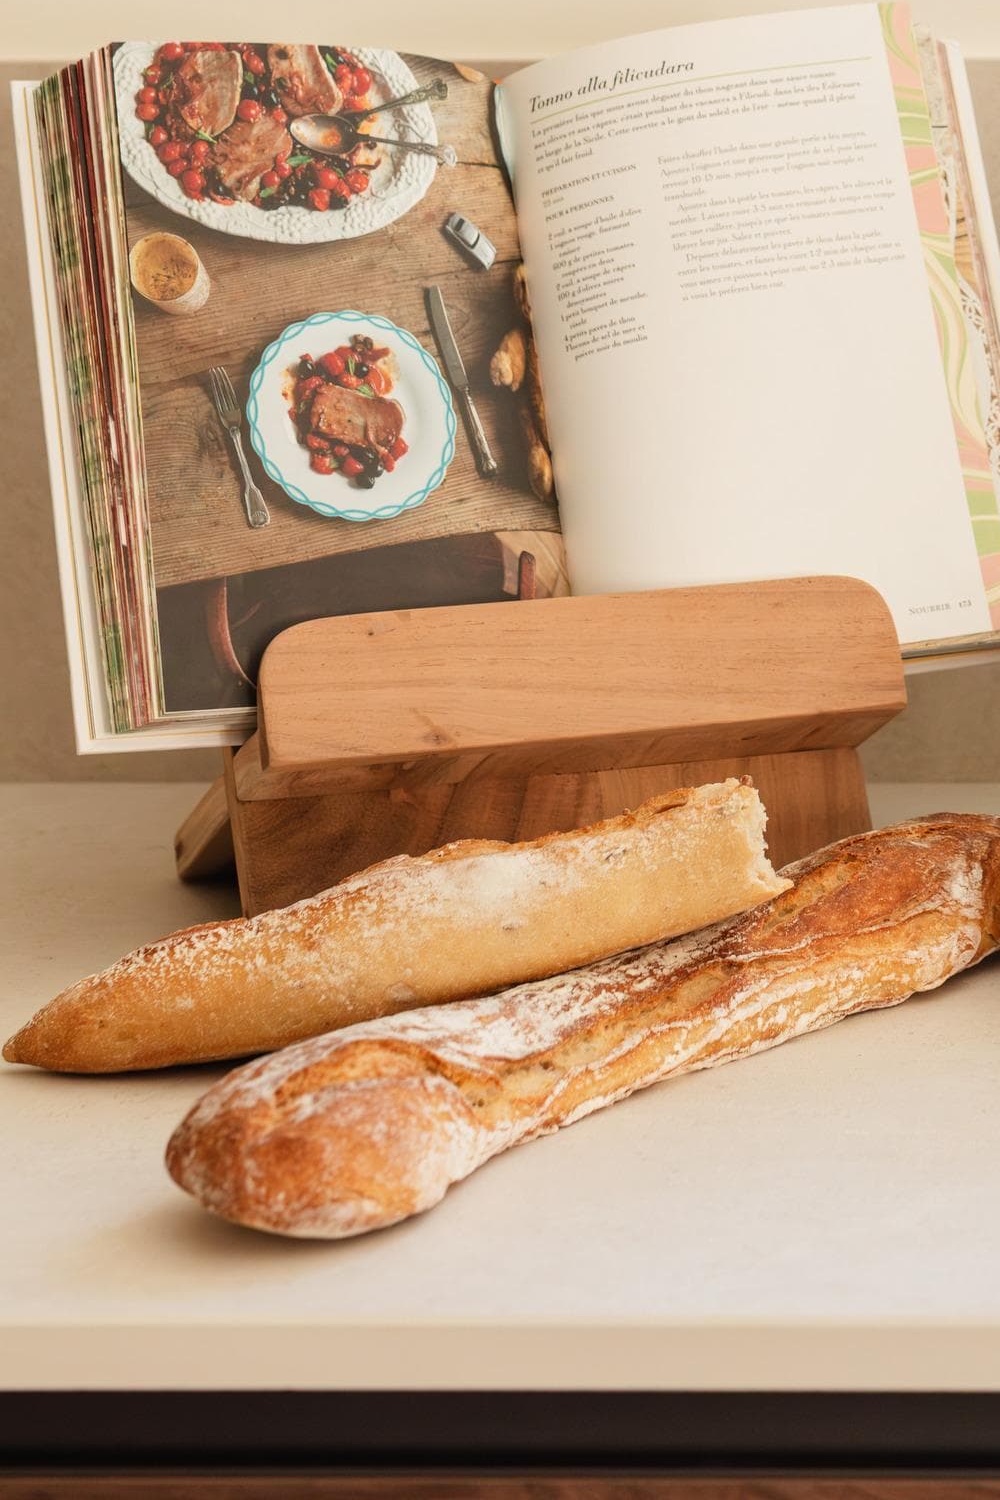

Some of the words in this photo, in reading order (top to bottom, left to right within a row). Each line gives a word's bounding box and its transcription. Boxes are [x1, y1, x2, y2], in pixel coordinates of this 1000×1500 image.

[530, 92, 573, 113] Tonno
[577, 76, 608, 96] alla
[609, 60, 695, 92] filicudara
